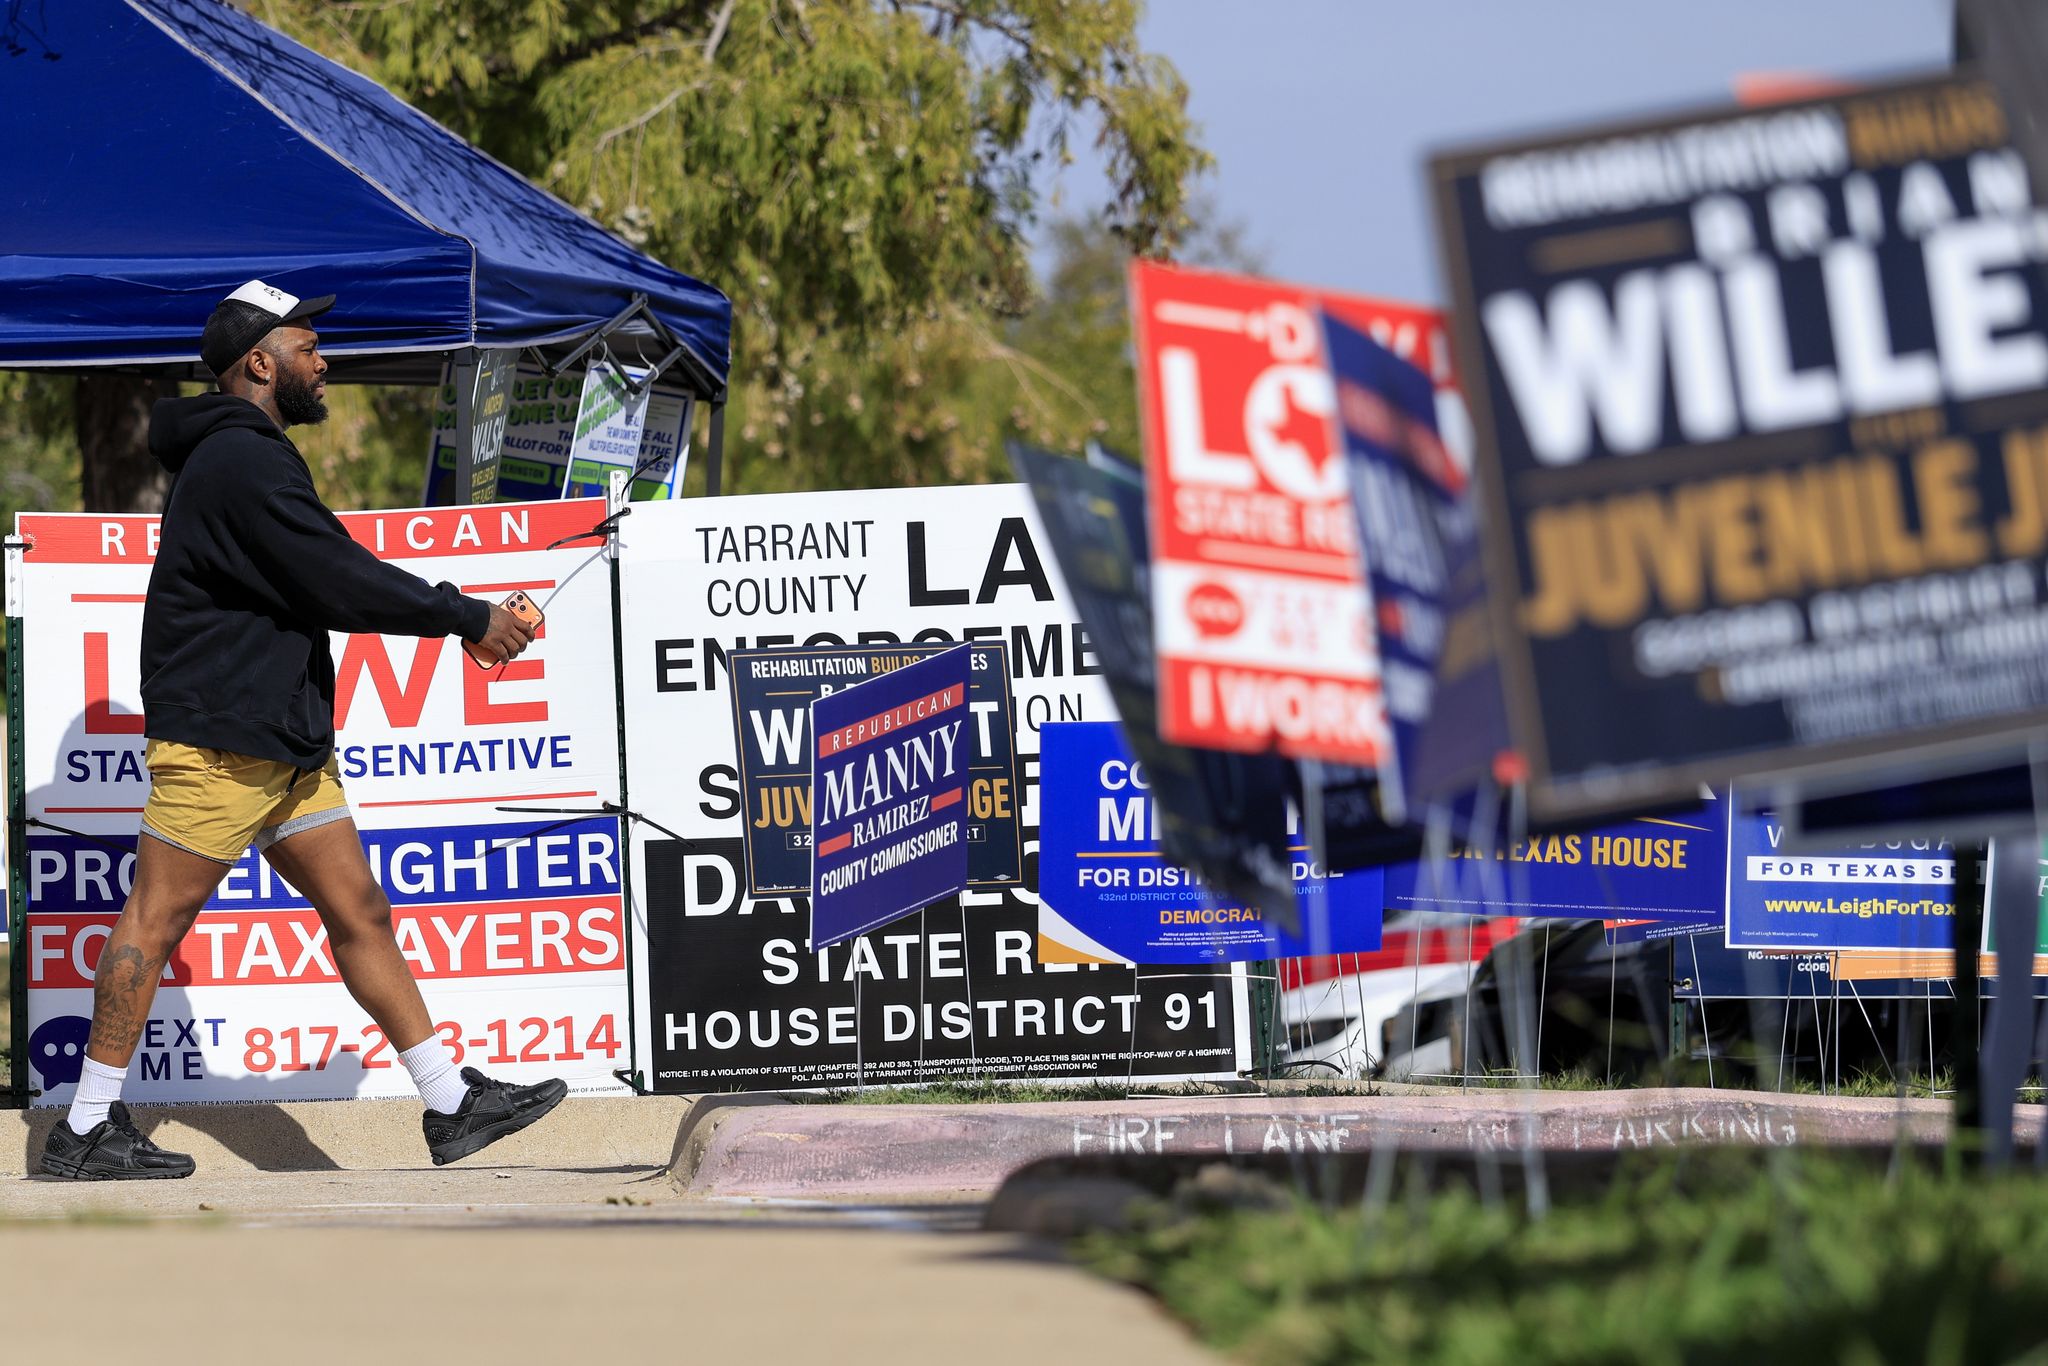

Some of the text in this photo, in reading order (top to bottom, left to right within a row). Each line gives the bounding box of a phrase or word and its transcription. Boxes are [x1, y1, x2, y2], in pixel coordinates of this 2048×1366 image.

[472, 414, 507, 465] WALSH
[503, 436, 539, 451] ALLOT
[102, 510, 529, 556] REICAN
[695, 520, 874, 564] TARRANT
[906, 516, 1056, 607] LA
[706, 573, 867, 617] COUNTY
[84, 620, 549, 734] LWE
[751, 657, 867, 679] REHABILITATION
[832, 690, 951, 751] REPUBLICAN
[820, 720, 962, 827] MANNY
[853, 794, 930, 849] RAMIREZ
[820, 857, 867, 897] COUNTY
[871, 820, 958, 877] COMMISSIONER
[1591, 835, 1689, 869] HOUSE
[1761, 862, 1814, 876] FOR
[1828, 863, 1916, 878] TEXAS
[1078, 868, 1130, 888] FOR
[1098, 893, 1127, 902] 432nd
[1130, 892, 1176, 902] DISTRICT
[195, 907, 620, 981] TAXAYERS
[145, 1018, 226, 1048] EXT
[664, 990, 1219, 1051] HOUSE DISTRICT 91
[141, 1051, 203, 1080] ME
[243, 1014, 622, 1073] 817-23-1214
[659, 1070, 690, 1079] NOTICE:
[692, 1070, 699, 1078] IT
[717, 1067, 758, 1076] VIOLATION
[760, 1066, 772, 1074] OF
[772, 1066, 797, 1074] STATE
[798, 1064, 816, 1073] LAW
[864, 1062, 877, 1070] 392
[913, 1058, 982, 1067] TRANSPORTATION
[1024, 1054, 1050, 1062] PLACE
[1052, 1054, 1070, 1062] THIS
[1070, 1053, 1090, 1062] SIGN
[1100, 1052, 1117, 1060] THE
[1118, 1050, 1174, 1060] RIGHT-OF-WAY
[1195, 1048, 1233, 1056] HIGHWAY.
[792, 1074, 810, 1082] POL.
[826, 1072, 844, 1080] PAID
[846, 1072, 862, 1080] FOR
[876, 1070, 912, 1078] TARRANT
[913, 1068, 946, 1076] COUNTY
[966, 1064, 1026, 1074] ENFORCEMENT
[1028, 1062, 1081, 1072] ASSOCIATION
[1082, 1062, 1098, 1070] PAC
